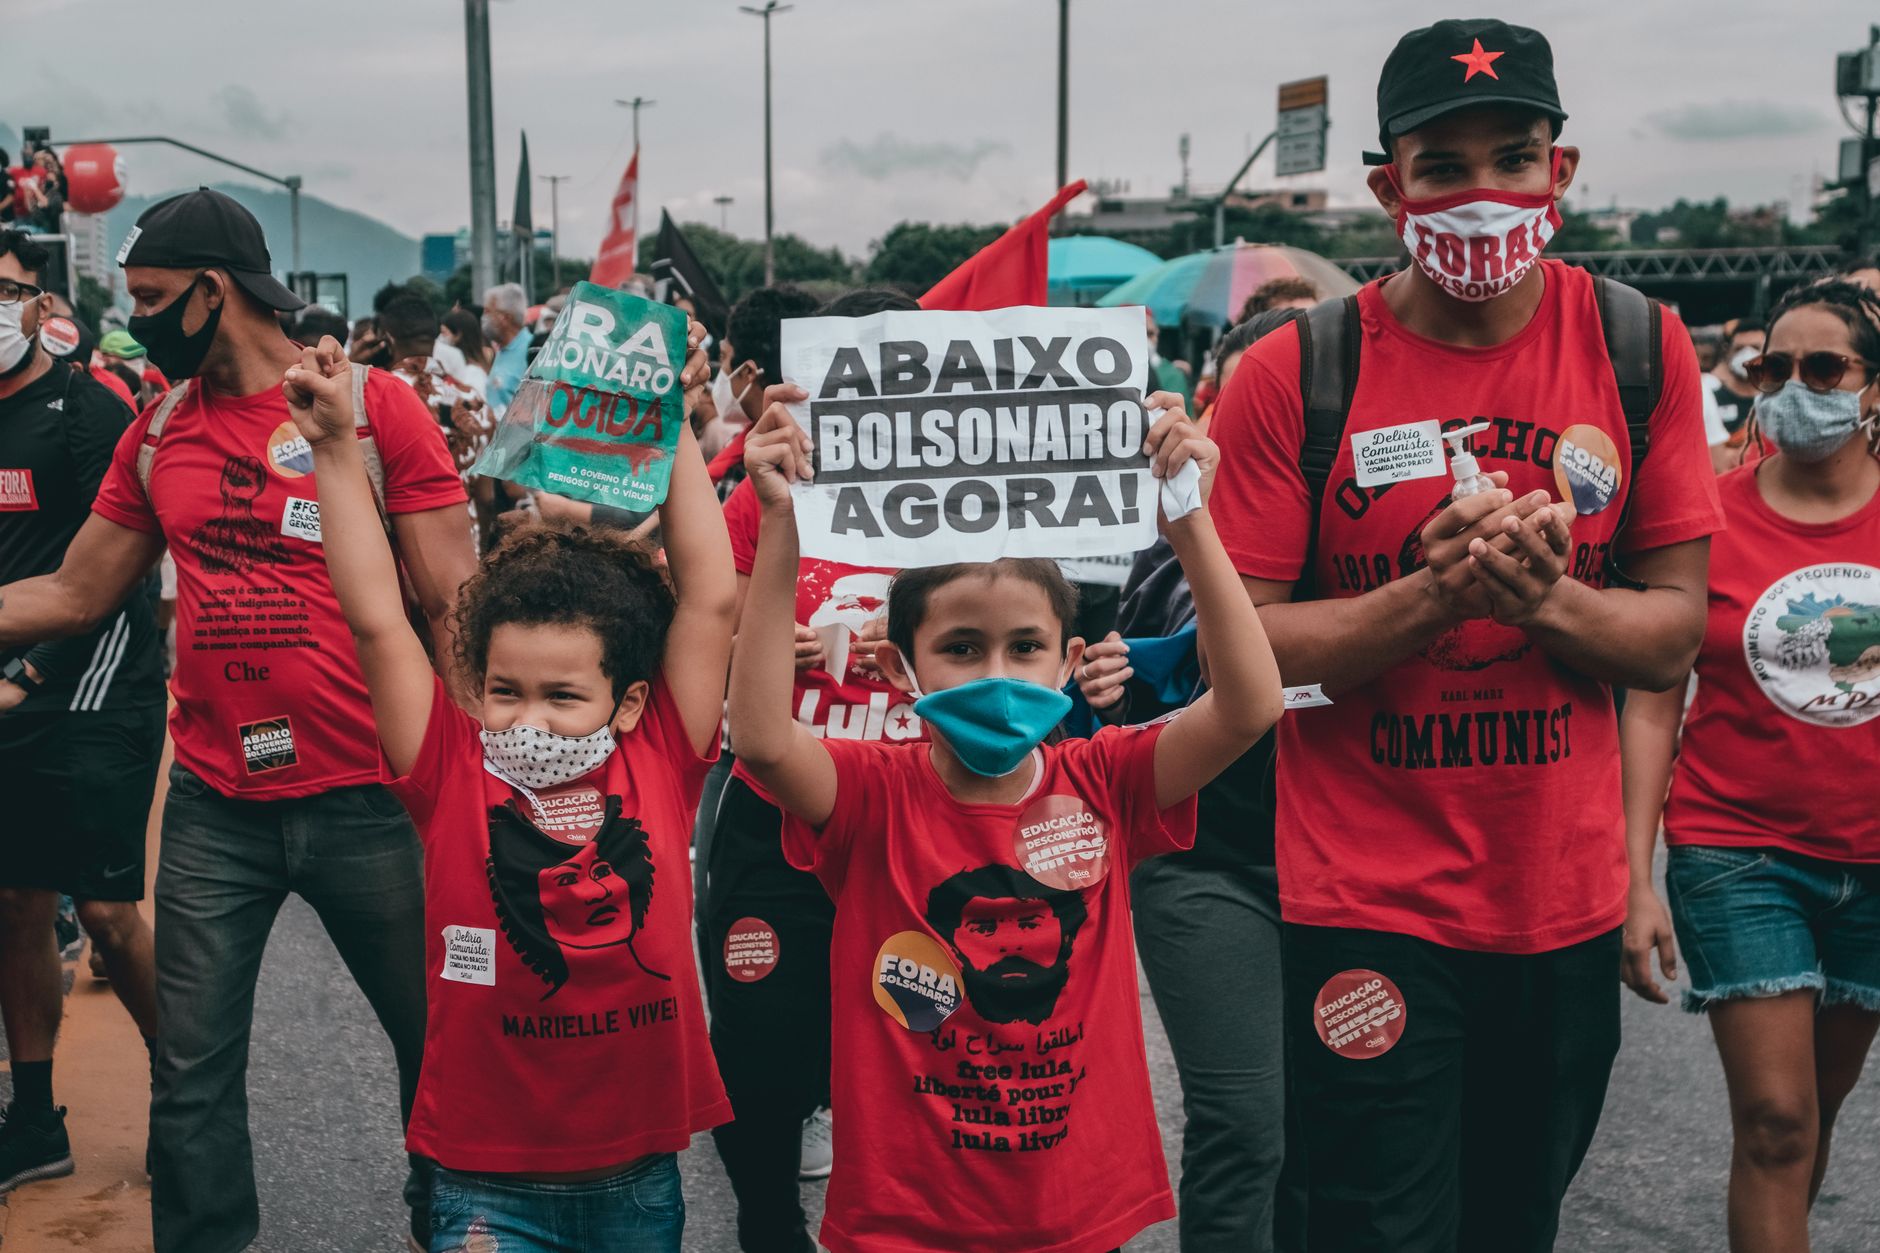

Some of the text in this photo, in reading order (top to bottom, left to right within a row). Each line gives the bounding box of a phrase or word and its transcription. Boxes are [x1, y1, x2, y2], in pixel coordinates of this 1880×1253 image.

[1415, 214, 1546, 282] FORA!
[551, 300, 671, 366] ORA
[537, 340, 675, 395] OLSONARO
[817, 335, 1133, 399] ABAIXO
[272, 436, 312, 460] FOR
[818, 400, 1143, 472] BOLSONARO
[1361, 437, 1435, 459] Comunista:
[1364, 456, 1391, 466] VACINA
[1392, 454, 1403, 462] NO
[1367, 457, 1433, 474] COMIDA NO PRATO!
[1561, 438, 1616, 487] FORA
[0, 471, 30, 494] FORA
[548, 472, 654, 502] PERIGOSO QUE O VÍRUS!
[570, 466, 656, 492] O GOVERNO É MAIS
[1559, 455, 1613, 496] BOLSONARO!
[290, 511, 320, 523] BOLSON
[292, 500, 319, 515] #FO
[830, 472, 1141, 539] AGORA!
[289, 519, 321, 532] GENOC
[247, 586, 279, 596] capaz
[234, 599, 297, 609] indignação
[231, 614, 252, 624] que
[269, 613, 309, 621] comete
[269, 625, 312, 636] mundo,
[1748, 607, 1770, 681] MOVIMENTO
[1795, 567, 1873, 582] PEQUENOS
[239, 638, 319, 651] companheiros
[223, 660, 271, 682] Che
[1440, 688, 1504, 702] KARL MARX
[797, 688, 923, 741] Lula
[243, 728, 290, 746] ABAIXO
[252, 737, 293, 751] GOVERNO
[1370, 702, 1572, 770] COMMUNIST
[245, 743, 294, 759] BOLSONARO
[533, 803, 601, 817] DSCONSTRÓI
[1020, 811, 1094, 839] EDUCAÇÃO
[1025, 825, 1100, 851] DESCONSTRÓI
[1025, 836, 1108, 874] MITOS
[1068, 870, 1090, 880] Chico
[729, 931, 772, 942] EDUCAÇÃO
[727, 949, 774, 967] MITOS
[880, 954, 956, 997] FORA
[878, 973, 956, 1008] BOLSONARO!
[1319, 978, 1383, 1018] EDUCAÇÃO
[502, 996, 678, 1039] MARIELLE VIVE!
[1324, 989, 1389, 1028] DESCONSTRÓI
[1327, 998, 1401, 1049] MITOS
[1365, 1036, 1384, 1048] Chico
[956, 1060, 1013, 1081] free
[1019, 1059, 1073, 1080] lula
[913, 1075, 1065, 1106] liberté pour
[951, 1103, 1071, 1127] lula libr
[951, 1129, 1012, 1152] lula
